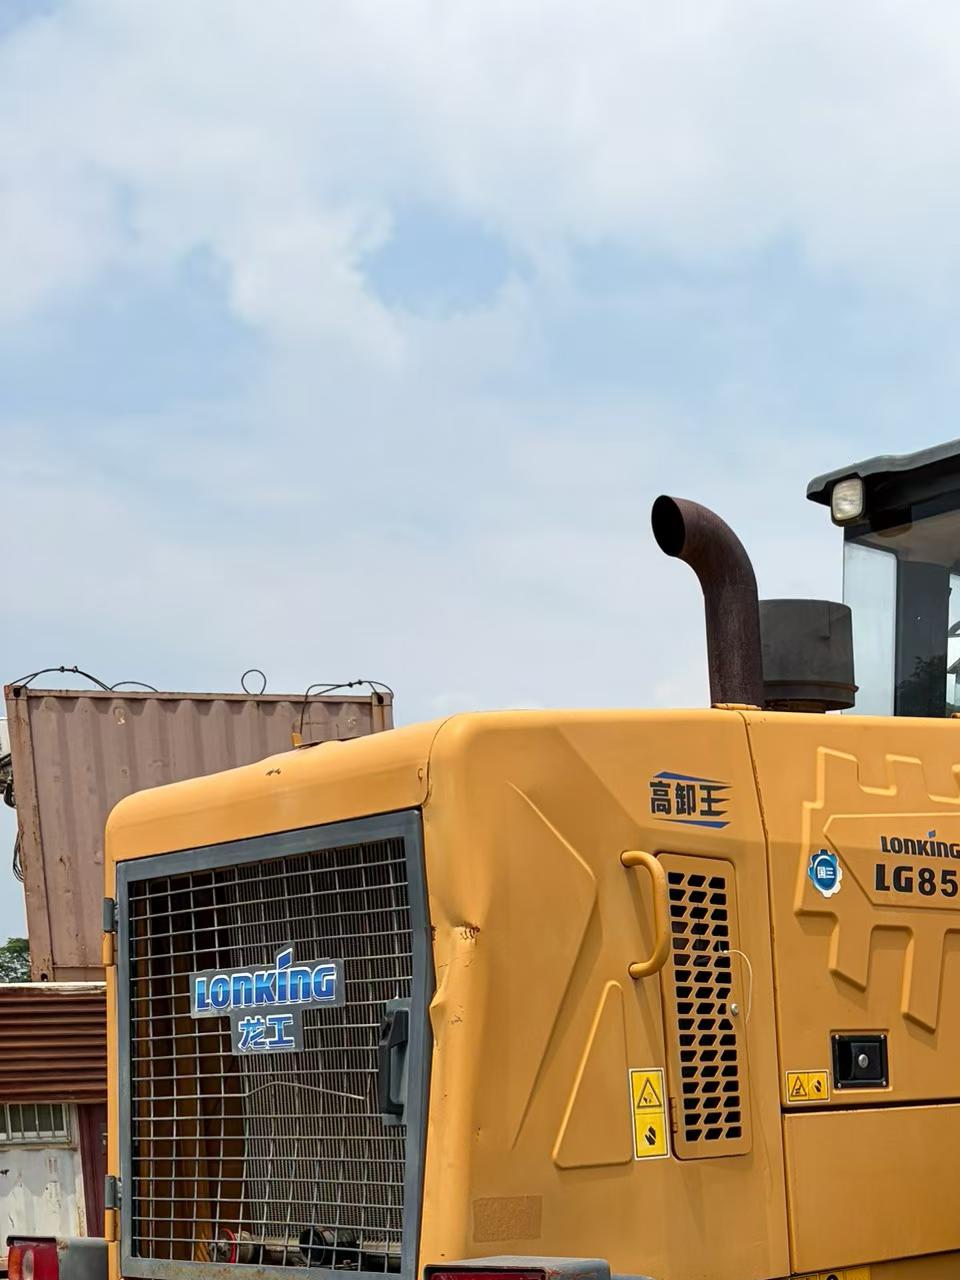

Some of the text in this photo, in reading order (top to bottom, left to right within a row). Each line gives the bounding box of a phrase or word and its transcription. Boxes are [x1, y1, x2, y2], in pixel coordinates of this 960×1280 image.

[649, 781, 733, 816] 高卸王
[238, 1014, 295, 1051] 龙工
